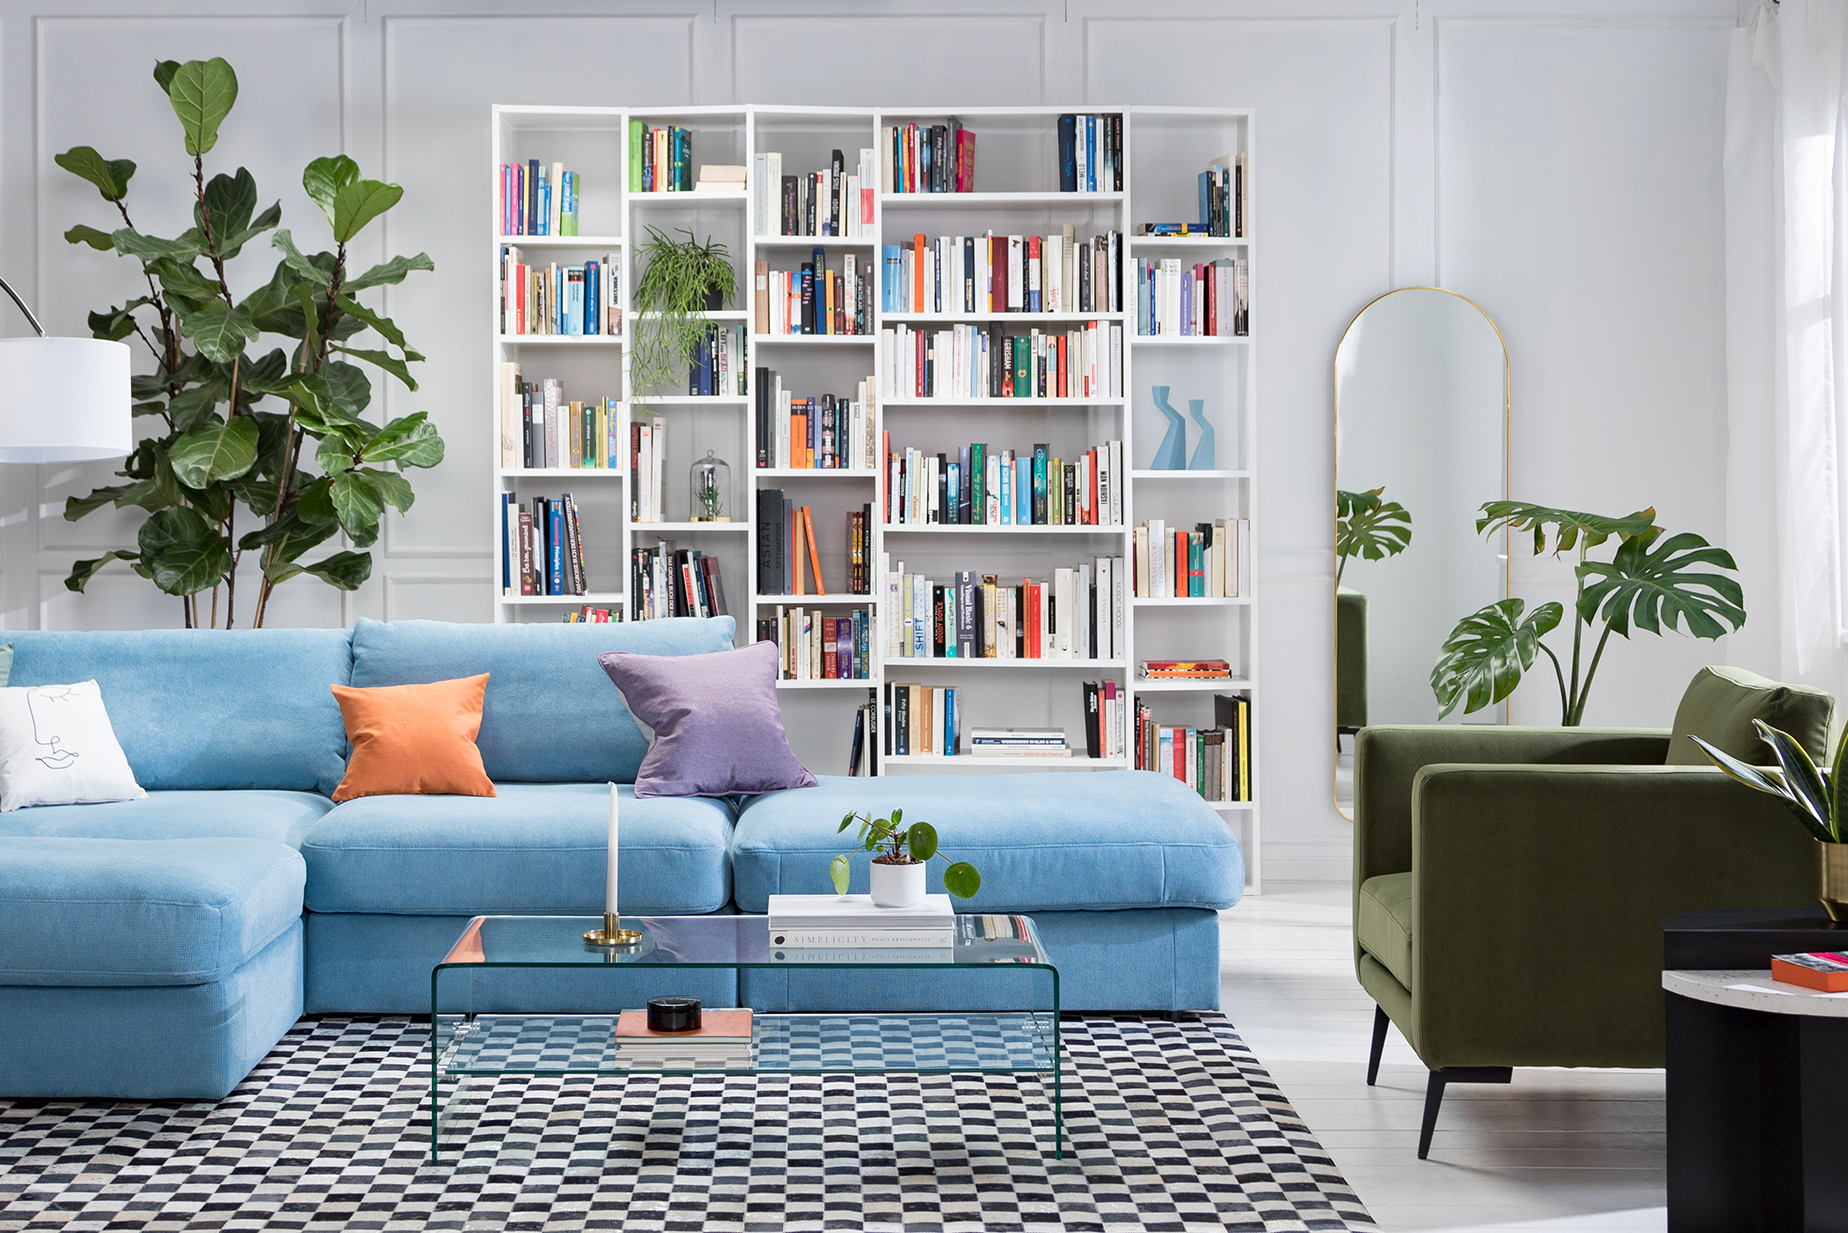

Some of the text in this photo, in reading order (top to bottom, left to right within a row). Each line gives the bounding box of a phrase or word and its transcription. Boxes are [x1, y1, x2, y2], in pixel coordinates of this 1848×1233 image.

[832, 161, 840, 190] VINTAGE STYLE
[761, 522, 770, 568] ASIAN
[915, 618, 924, 650] SHIFT
[794, 935, 868, 944] SIMPLICITY
